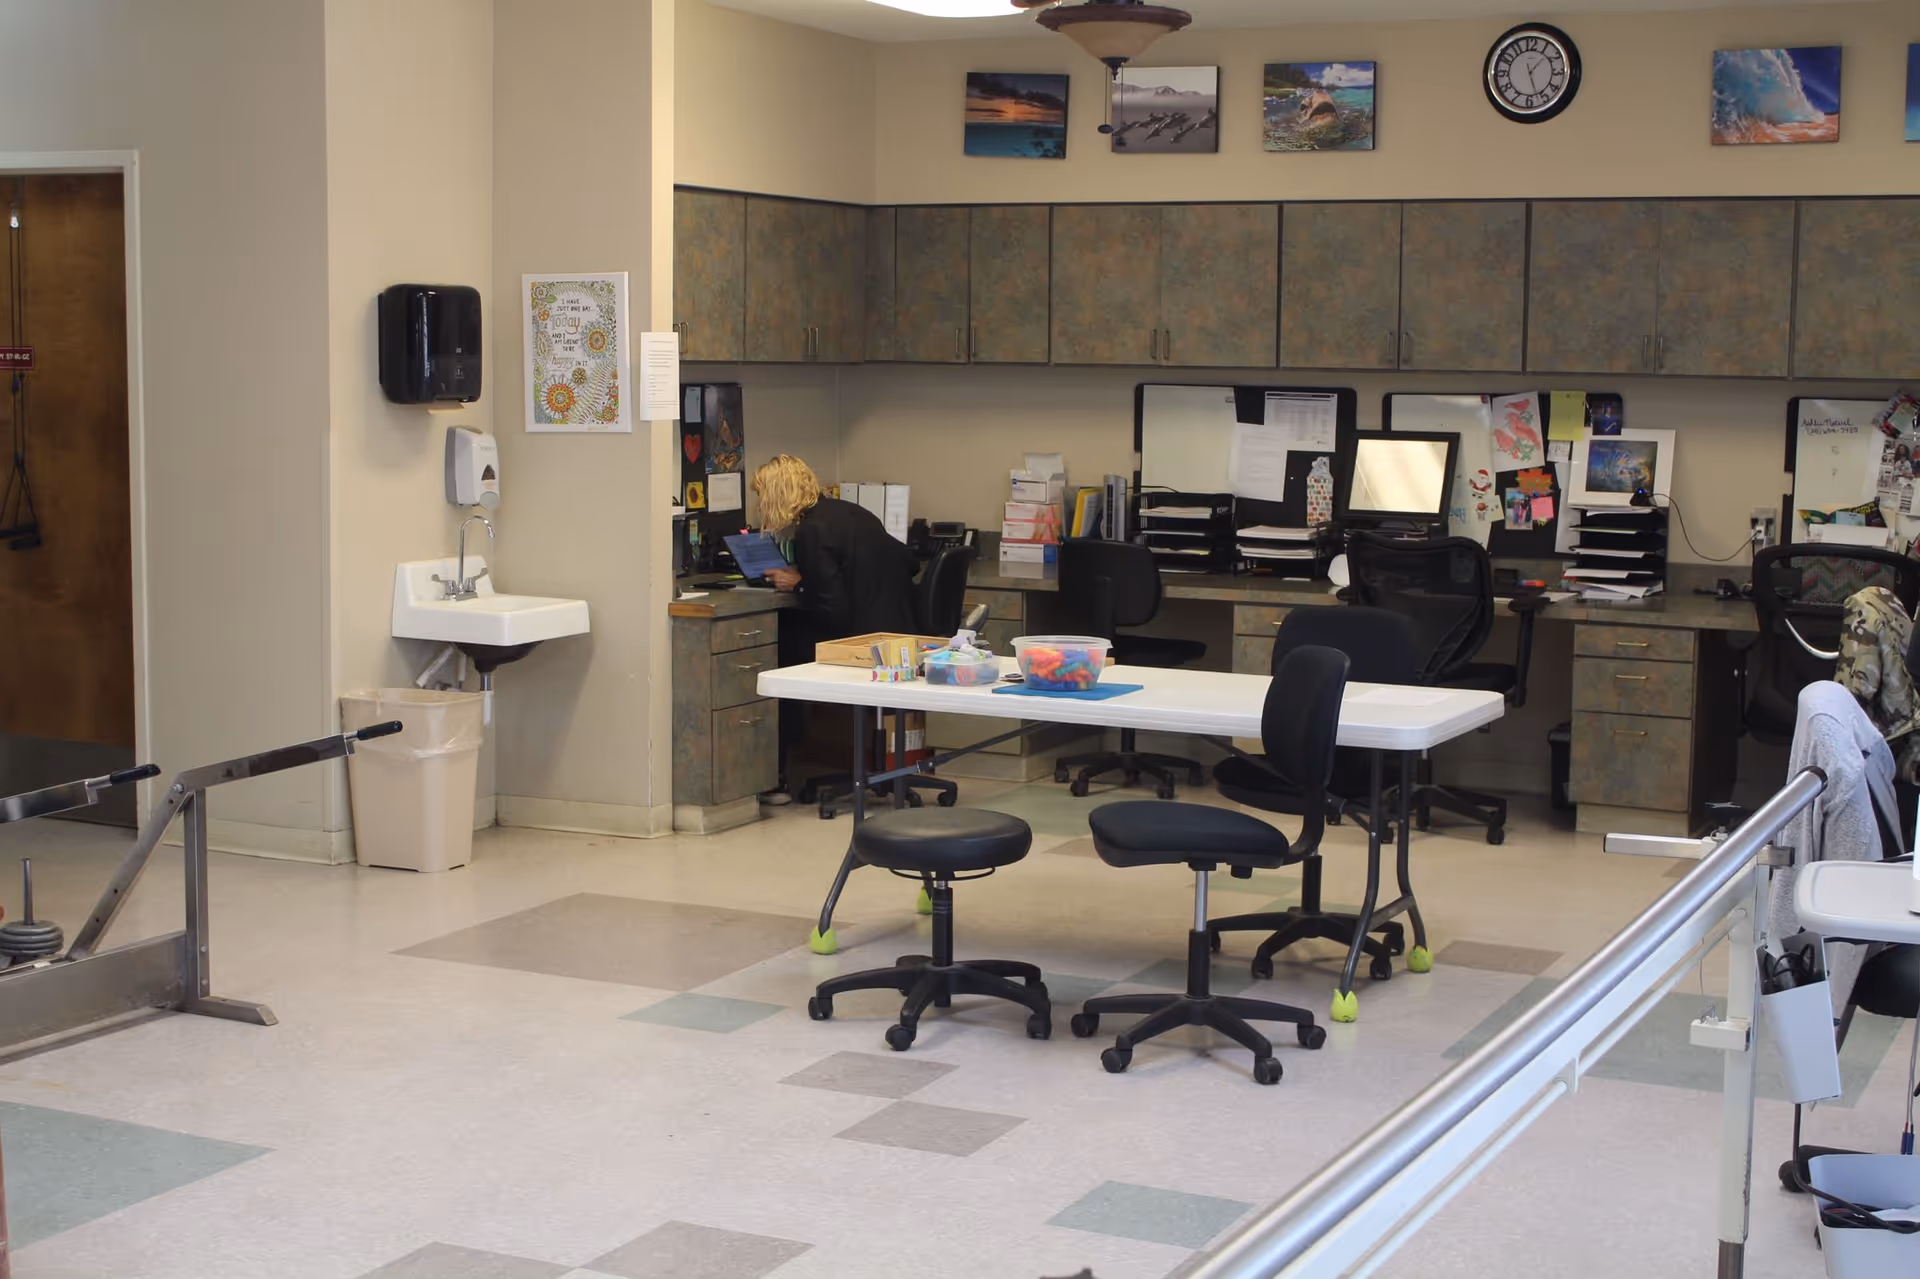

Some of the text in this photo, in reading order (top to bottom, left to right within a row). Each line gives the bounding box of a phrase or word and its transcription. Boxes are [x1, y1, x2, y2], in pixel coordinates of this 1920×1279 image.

[1512, 42, 1523, 56] 11
[1526, 39, 1537, 51] 12
[1541, 42, 1549, 53] 1
[1501, 52, 1514, 65] 10
[1549, 48, 1562, 60] 2
[1552, 68, 1564, 76] 3
[1500, 83, 1512, 92] 8
[1550, 82, 1560, 93] 4
[1512, 91, 1521, 102] 7
[1525, 95, 1533, 108] 6
[1540, 91, 1550, 104] 5
